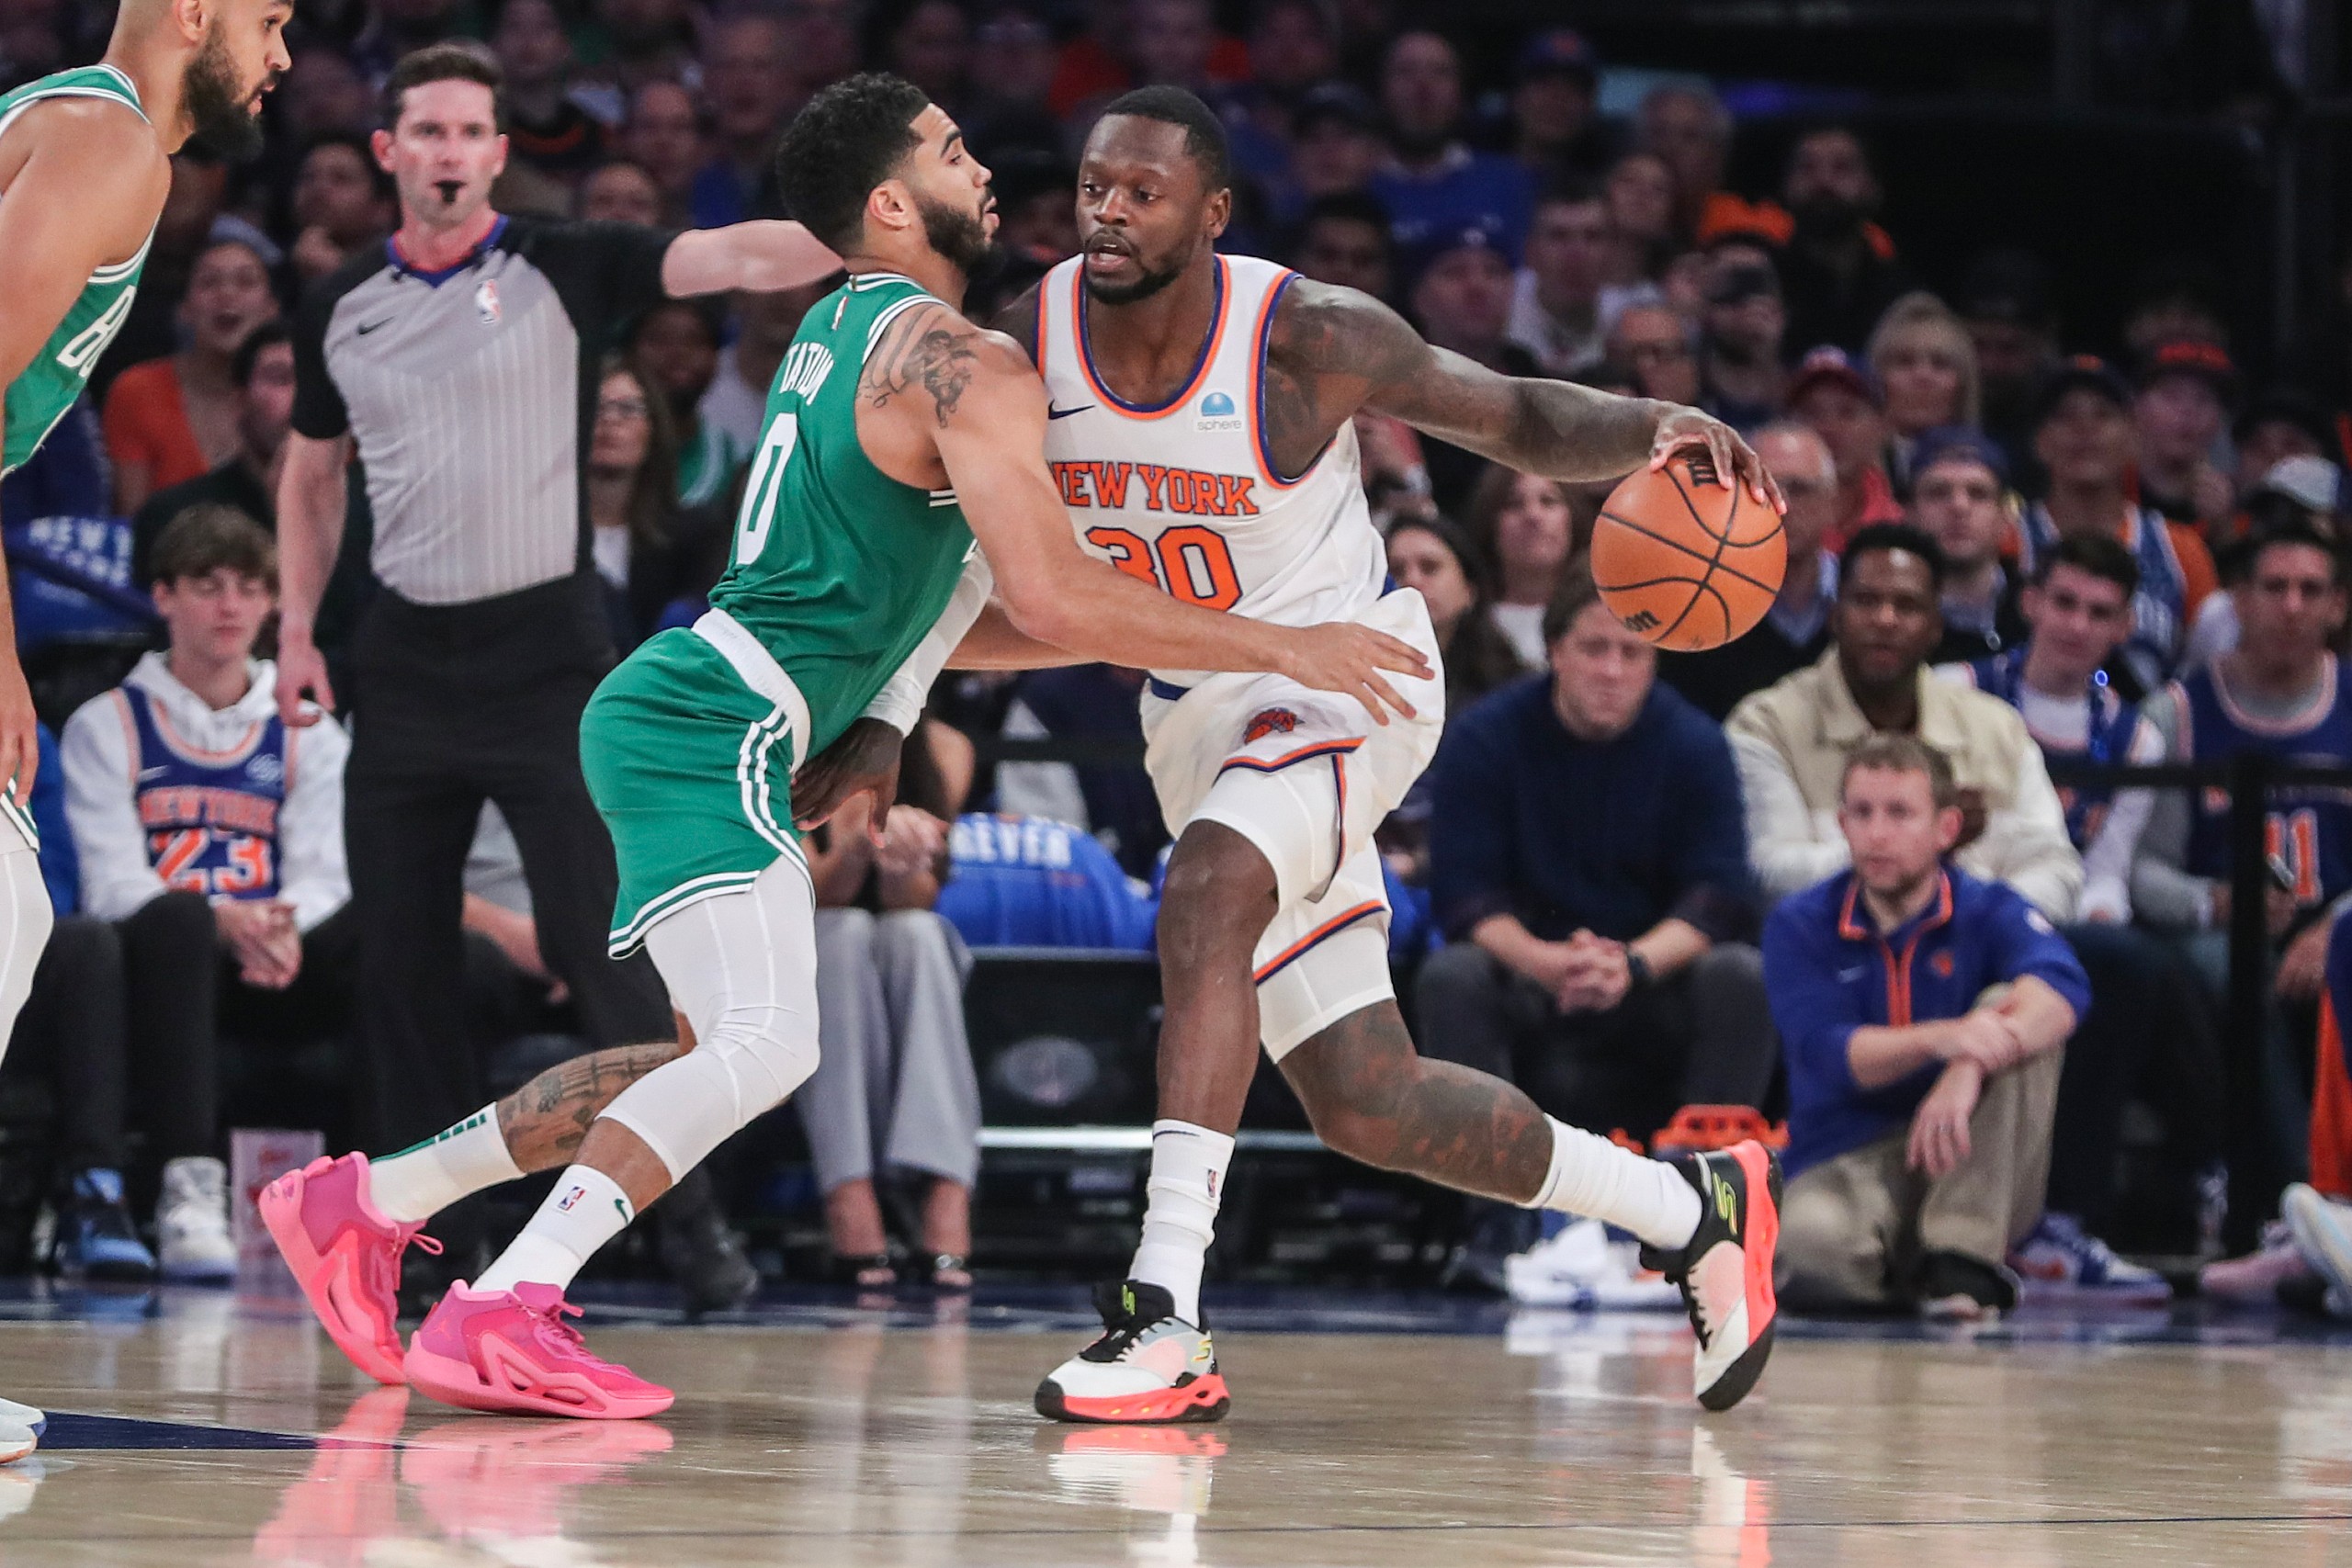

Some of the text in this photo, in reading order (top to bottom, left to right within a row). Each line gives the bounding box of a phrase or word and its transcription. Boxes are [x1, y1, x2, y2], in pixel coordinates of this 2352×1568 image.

[779, 342, 834, 406] TATUM
[1197, 418, 1242, 431] sphere
[736, 412, 797, 565] 0
[1136, 463, 1260, 516] YORK
[1085, 524, 1244, 613] 30
[150, 826, 273, 893] 23
